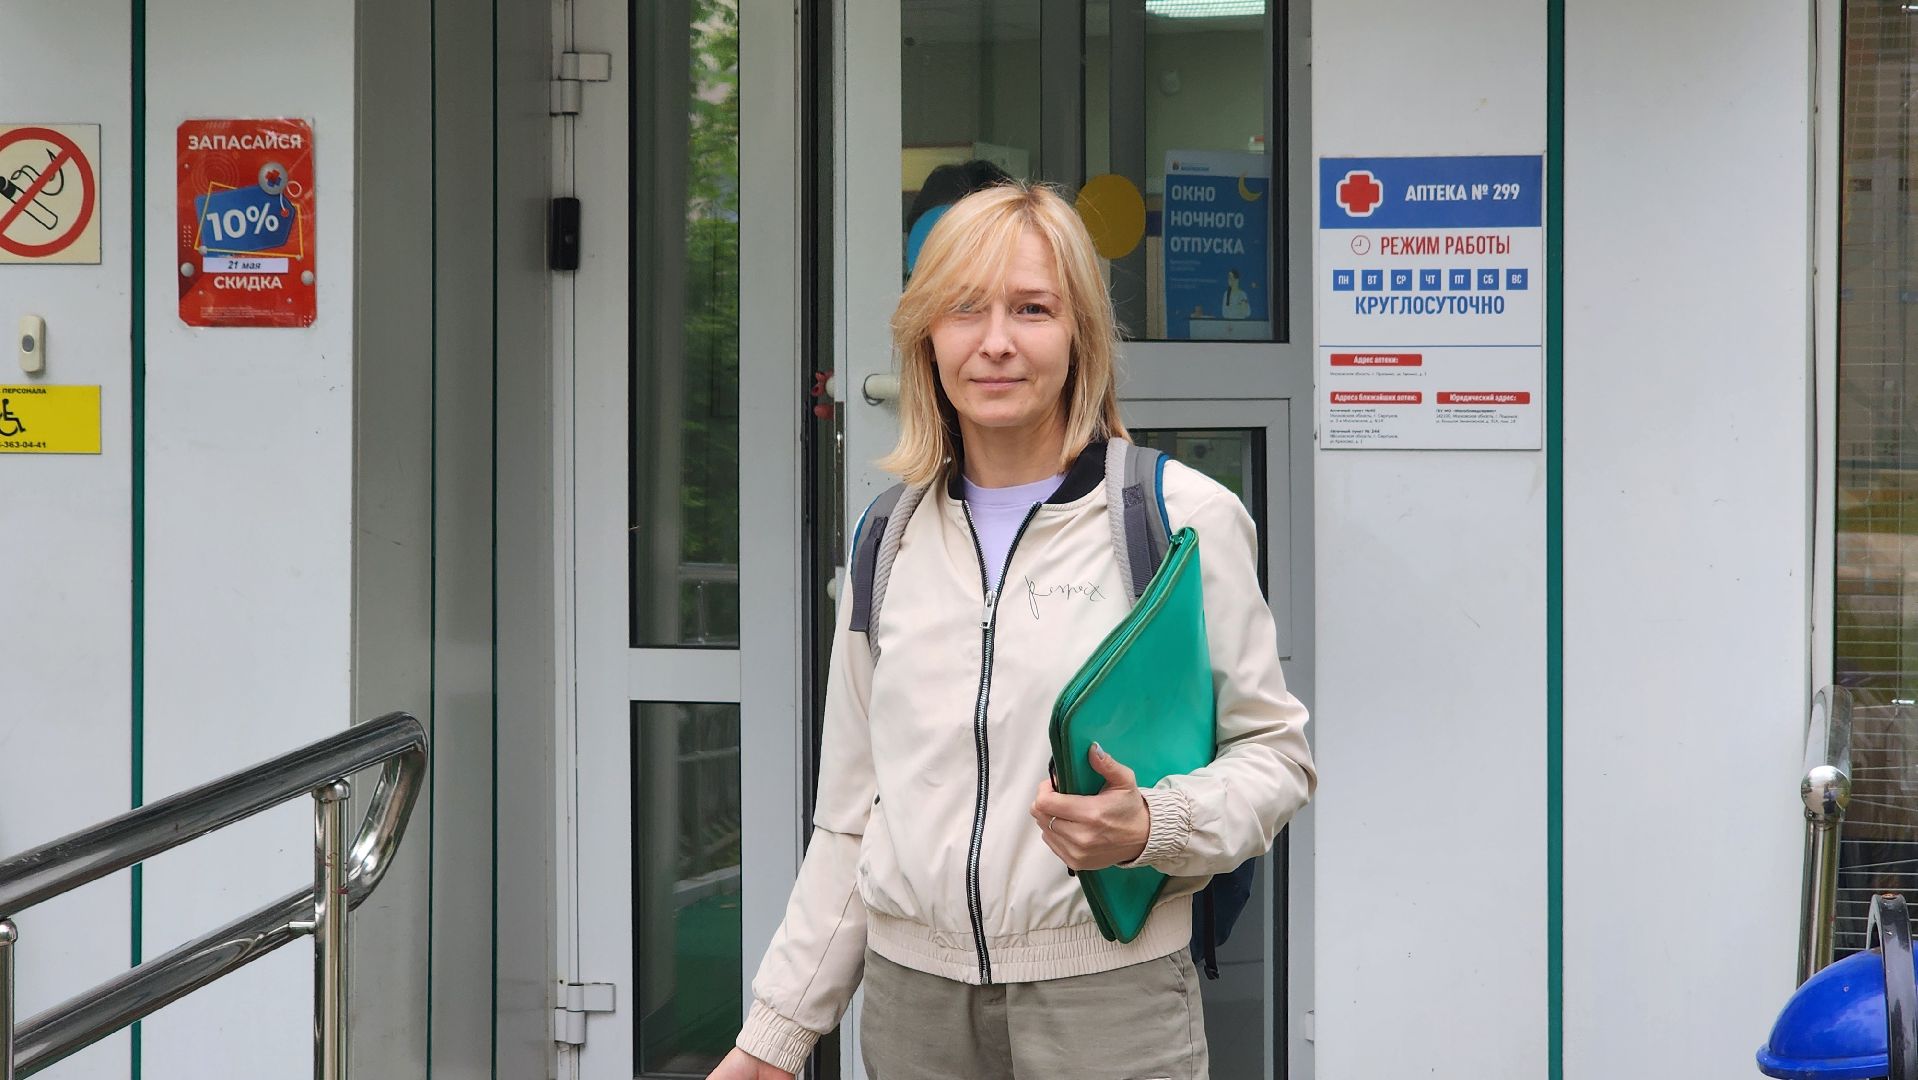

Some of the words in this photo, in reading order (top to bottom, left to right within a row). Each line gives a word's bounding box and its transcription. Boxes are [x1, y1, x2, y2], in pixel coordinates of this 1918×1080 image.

[187, 133, 302, 150] ЗАПАСАЙСЯ
[1171, 185, 1216, 202] ОКНО
[1405, 184, 1467, 201] АПТЕКА
[1472, 184, 1488, 200] №
[1493, 183, 1520, 200] 299
[206, 202, 280, 242] 10%
[1170, 210, 1245, 229] НОЧНОГО
[1170, 236, 1245, 255] ОТПУСКА
[1381, 236, 1440, 255] РЕЖИМ
[1445, 235, 1510, 255] РАБОТЫ
[228, 261, 238, 270] 21
[213, 276, 283, 291] СКИДКА
[1338, 275, 1349, 285] ПН
[1367, 275, 1377, 285] ВТ
[1396, 275, 1407, 285] СР
[1425, 275, 1435, 284] ЧТ
[1454, 274, 1465, 284] ПТ
[1483, 274, 1494, 284] СБ
[1511, 274, 1522, 284] ВС
[1355, 296, 1505, 315] КРУГЛОСУТОЧНО
[1353, 355, 1373, 365] Адрес
[1334, 393, 1358, 402] Адреса
[1449, 393, 1494, 402] Юридический
[0, 441, 46, 449] -363-04-41
